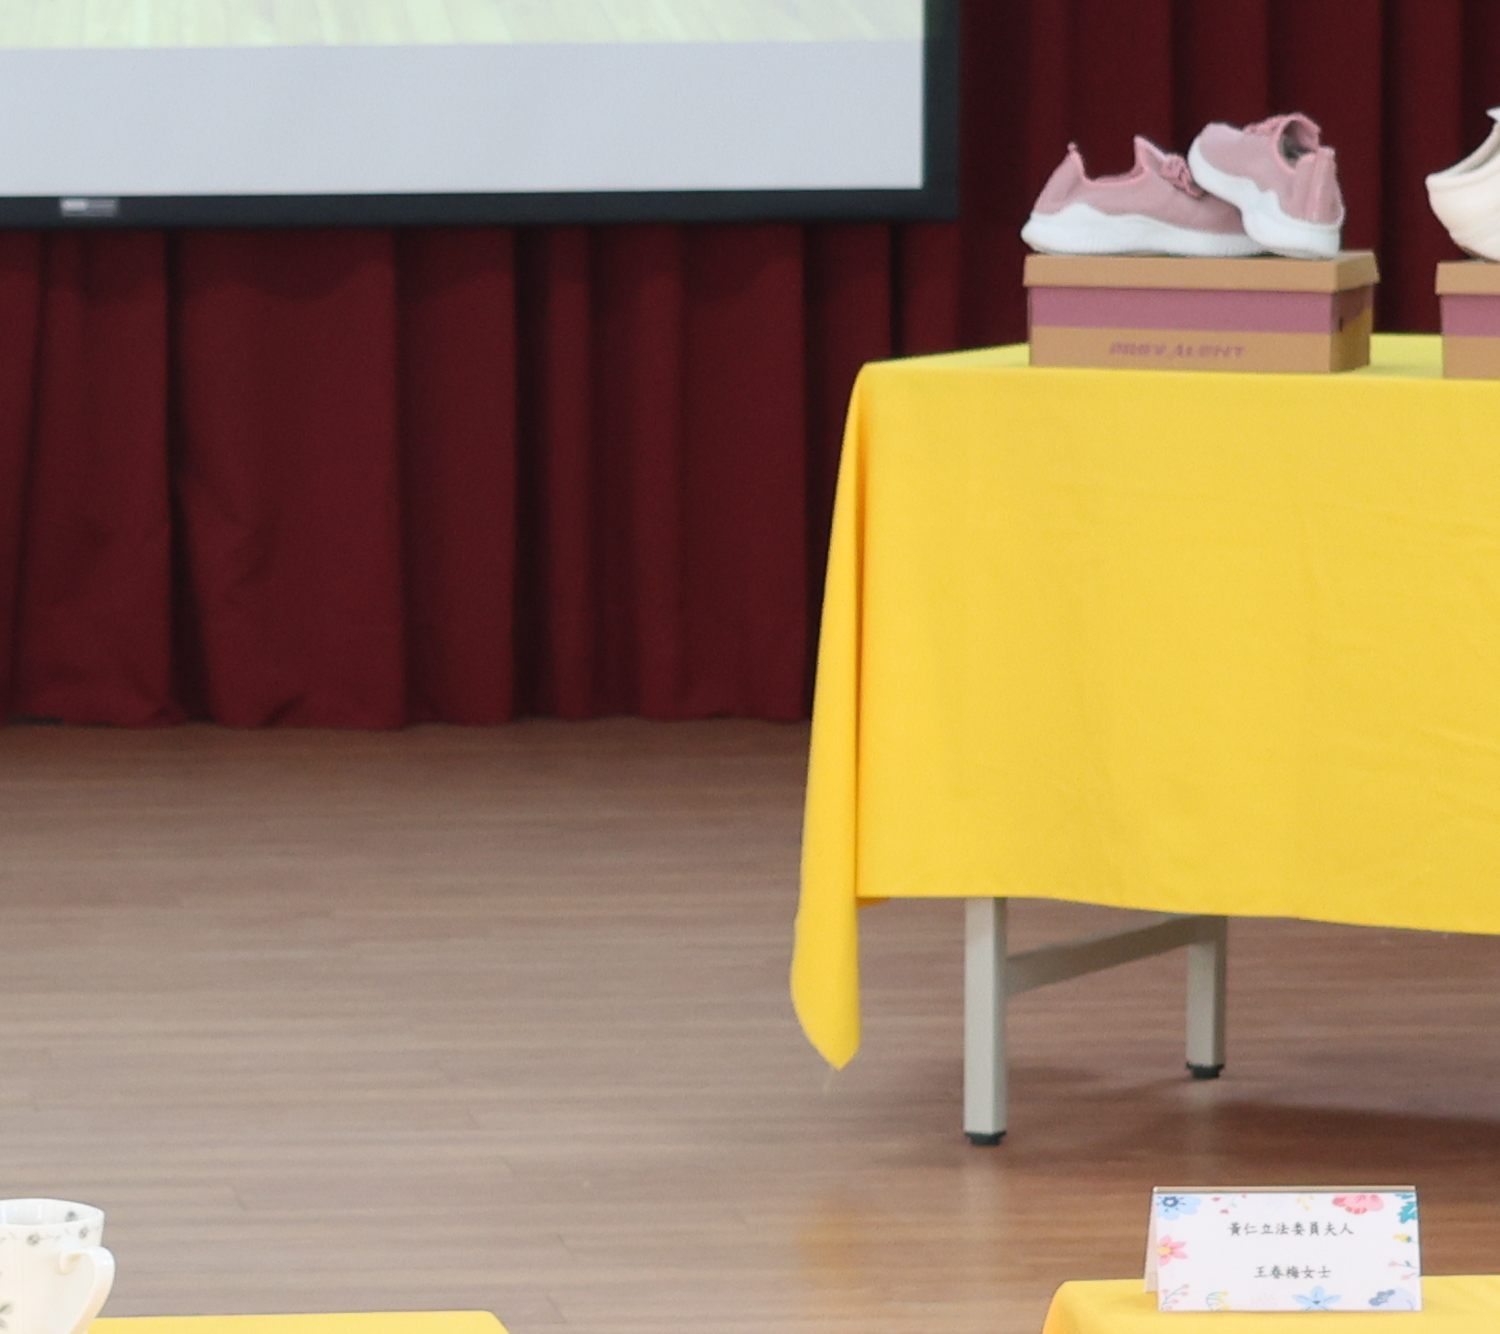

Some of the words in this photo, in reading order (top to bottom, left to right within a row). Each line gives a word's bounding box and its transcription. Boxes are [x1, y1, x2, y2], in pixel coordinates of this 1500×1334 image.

[1227, 1220, 1354, 1237] 黃仁立法委員夫人
[1253, 1265, 1332, 1280] 王春梅女士
